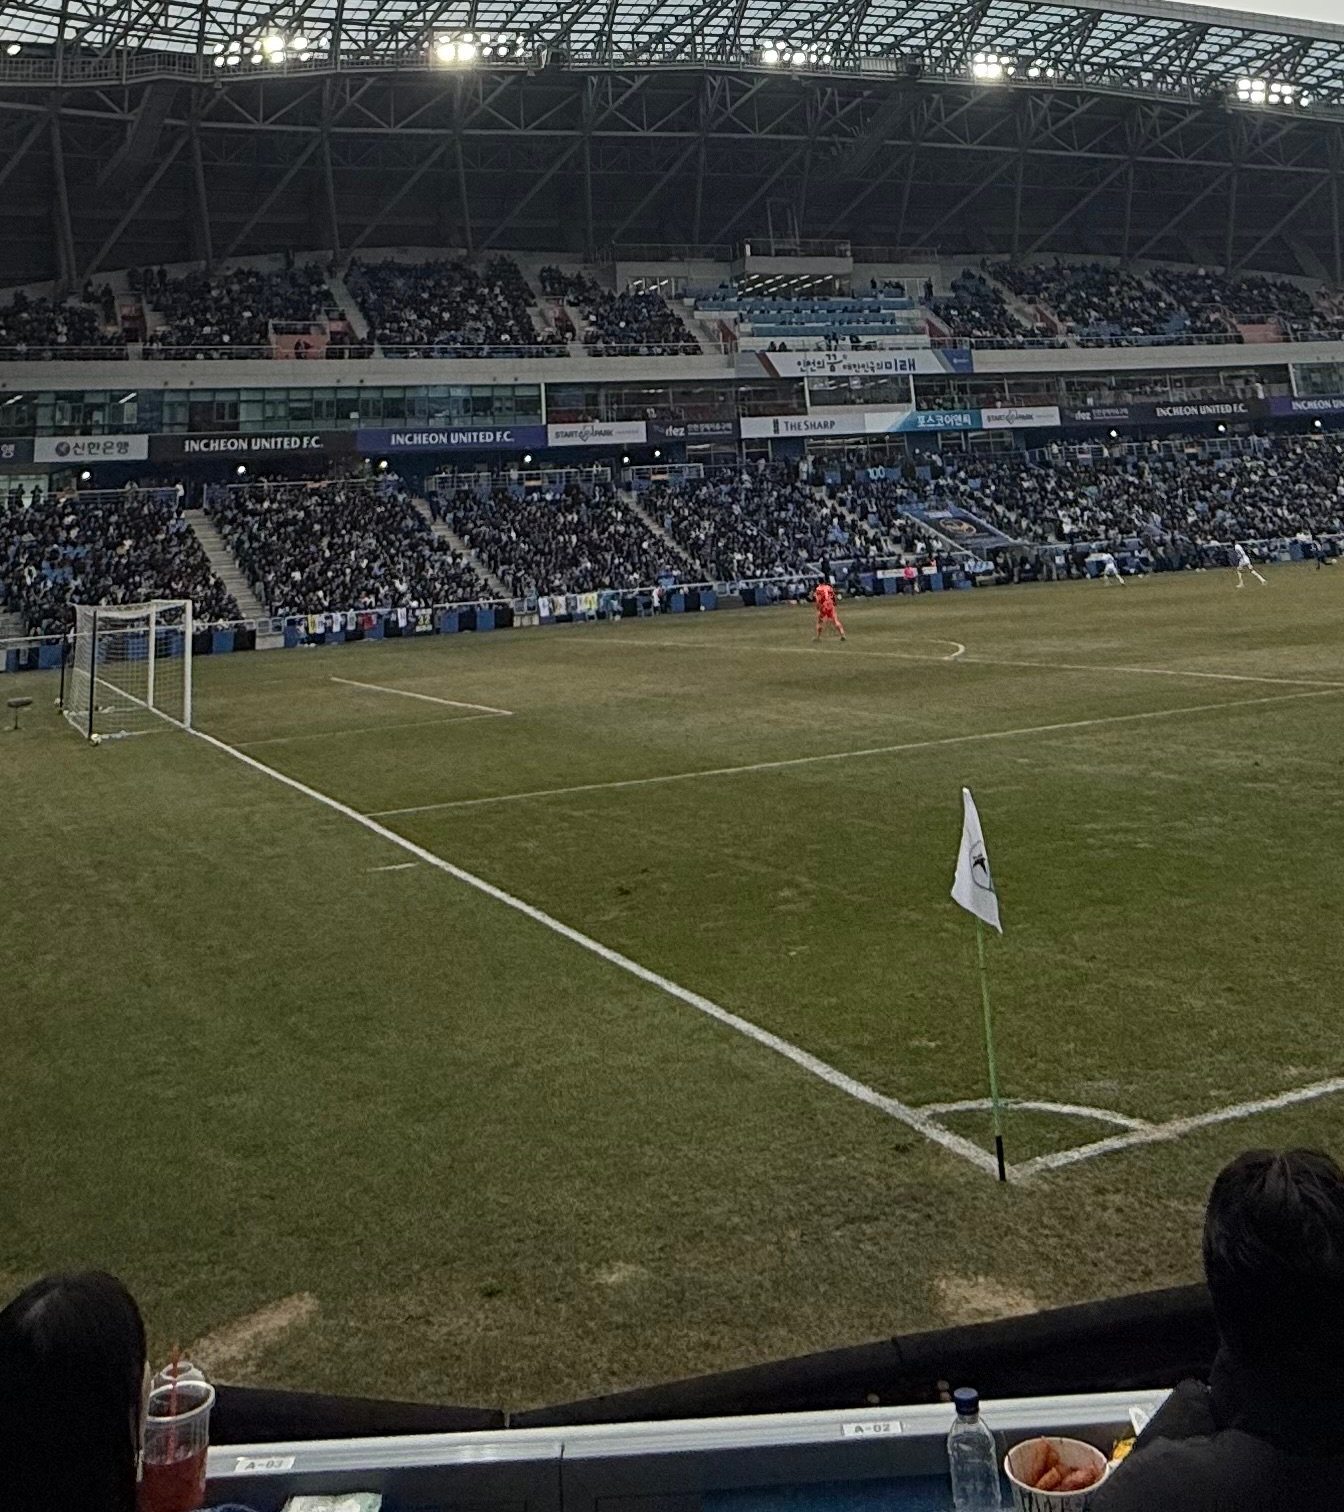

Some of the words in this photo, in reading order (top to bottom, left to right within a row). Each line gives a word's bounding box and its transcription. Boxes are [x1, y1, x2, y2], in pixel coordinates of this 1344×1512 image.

[1156, 406, 1198, 417] INCHEON
[1199, 404, 1232, 415] UNITED
[1291, 399, 1331, 410] INCHEON
[784, 420, 802, 432] THE
[803, 419, 836, 431] SHARP
[184, 438, 248, 452] INCHEON
[251, 436, 300, 450] UNITED
[303, 436, 324, 449] F.C.
[391, 432, 448, 445] INCHEON
[450, 431, 494, 444] UNITED
[496, 430, 515, 442] F.C.
[72, 440, 130, 456] 신한은행
[855, 1423, 891, 1433] A-02
